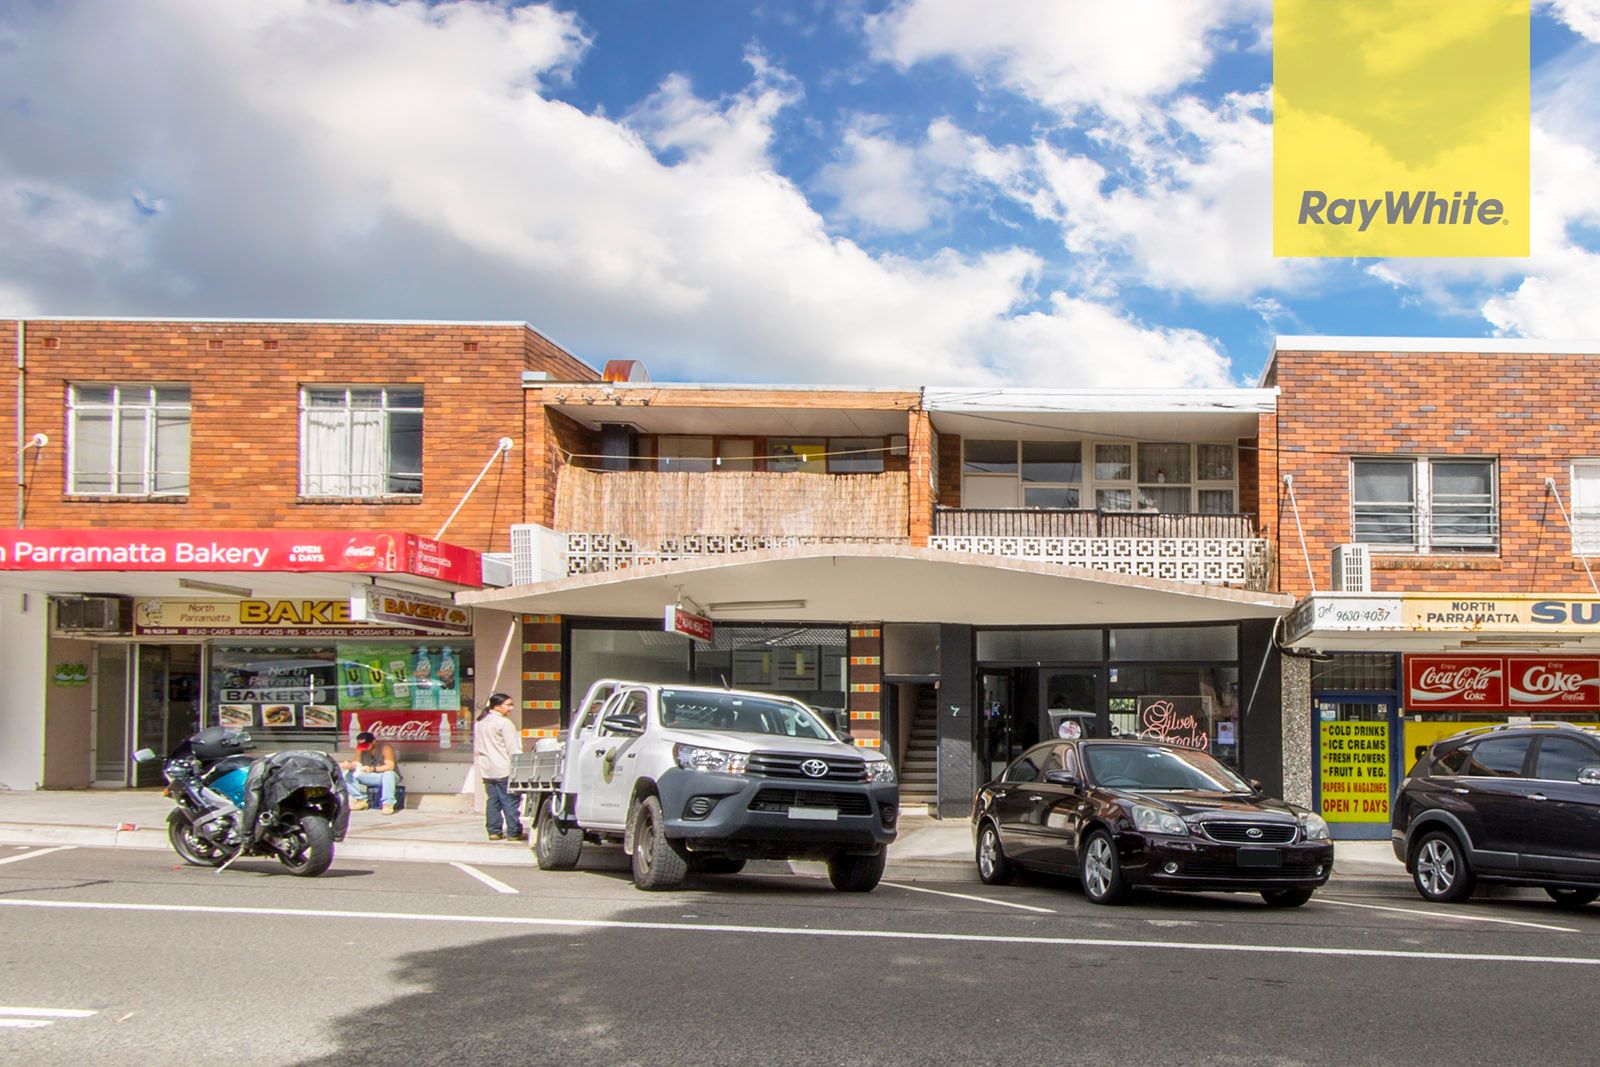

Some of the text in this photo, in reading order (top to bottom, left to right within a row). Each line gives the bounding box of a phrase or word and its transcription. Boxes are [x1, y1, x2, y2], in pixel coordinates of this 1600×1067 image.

[15, 542, 166, 563] Parramatta
[176, 542, 269, 567] Bakery
[292, 545, 322, 553] OPEN
[289, 554, 325, 562] 6 DAYS
[188, 604, 215, 612] North
[240, 600, 351, 624] BAKE
[384, 598, 448, 622] BAKERY
[1452, 601, 1496, 612] NORTH
[179, 614, 231, 622] Parramatta
[1427, 612, 1520, 624] PARRAMATTA
[268, 666, 308, 675] North
[1522, 666, 1583, 692] Coke
[1463, 691, 1487, 701] Coke
[950, 705, 961, 717] 7
[1328, 725, 1385, 737] COLD DRINKS
[1328, 739, 1386, 750] ICE CREAMS
[1328, 753, 1386, 764] FRESH FLOWERS
[1328, 767, 1387, 778] FRUIT & VEG.
[1322, 782, 1387, 793] PAPERS & MAGAZINES
[1323, 800, 1388, 813] OPEN 7 DAYS
